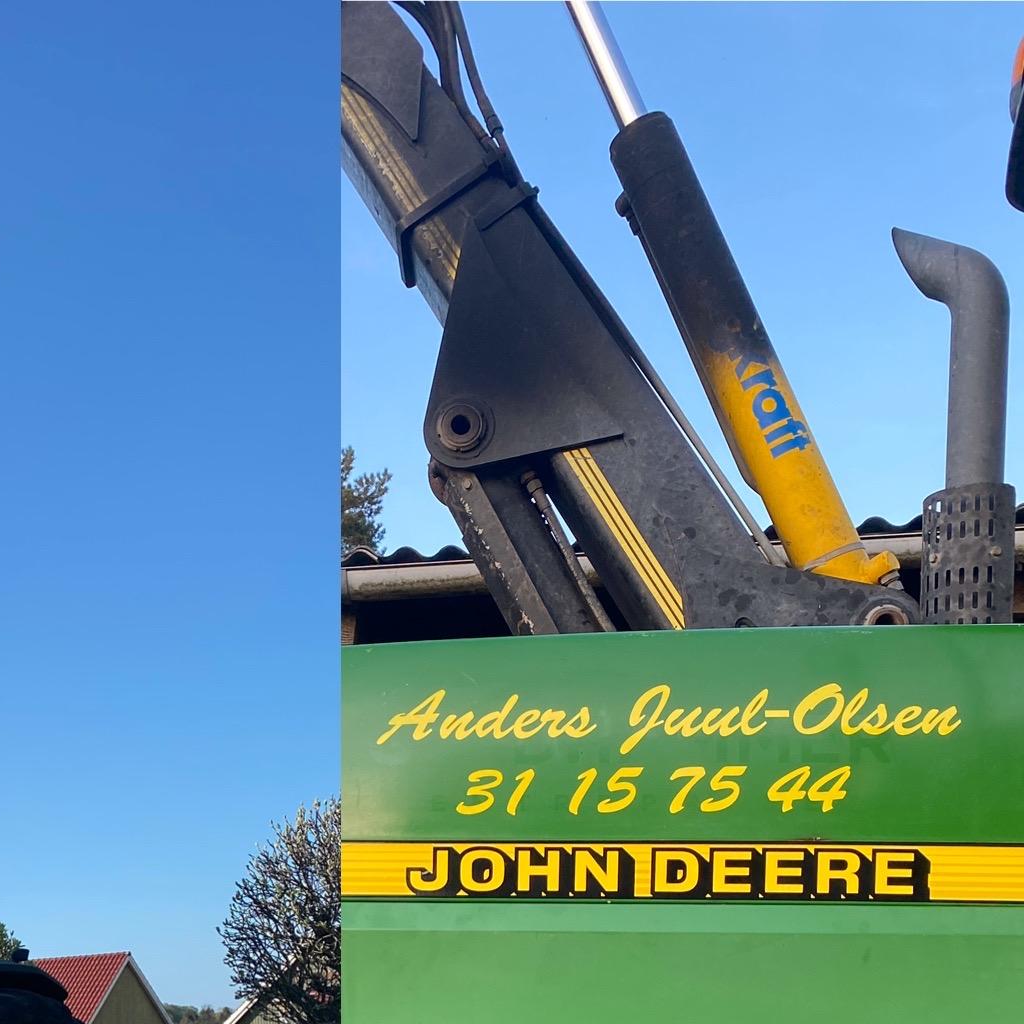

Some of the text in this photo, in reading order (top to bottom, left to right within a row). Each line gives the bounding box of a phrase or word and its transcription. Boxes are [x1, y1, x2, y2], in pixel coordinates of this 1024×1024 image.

[376, 682, 962, 755] Anders Juul-Olsen
[456, 765, 852, 817] 31 15 75 44
[407, 846, 922, 898] JOHN DEERE
